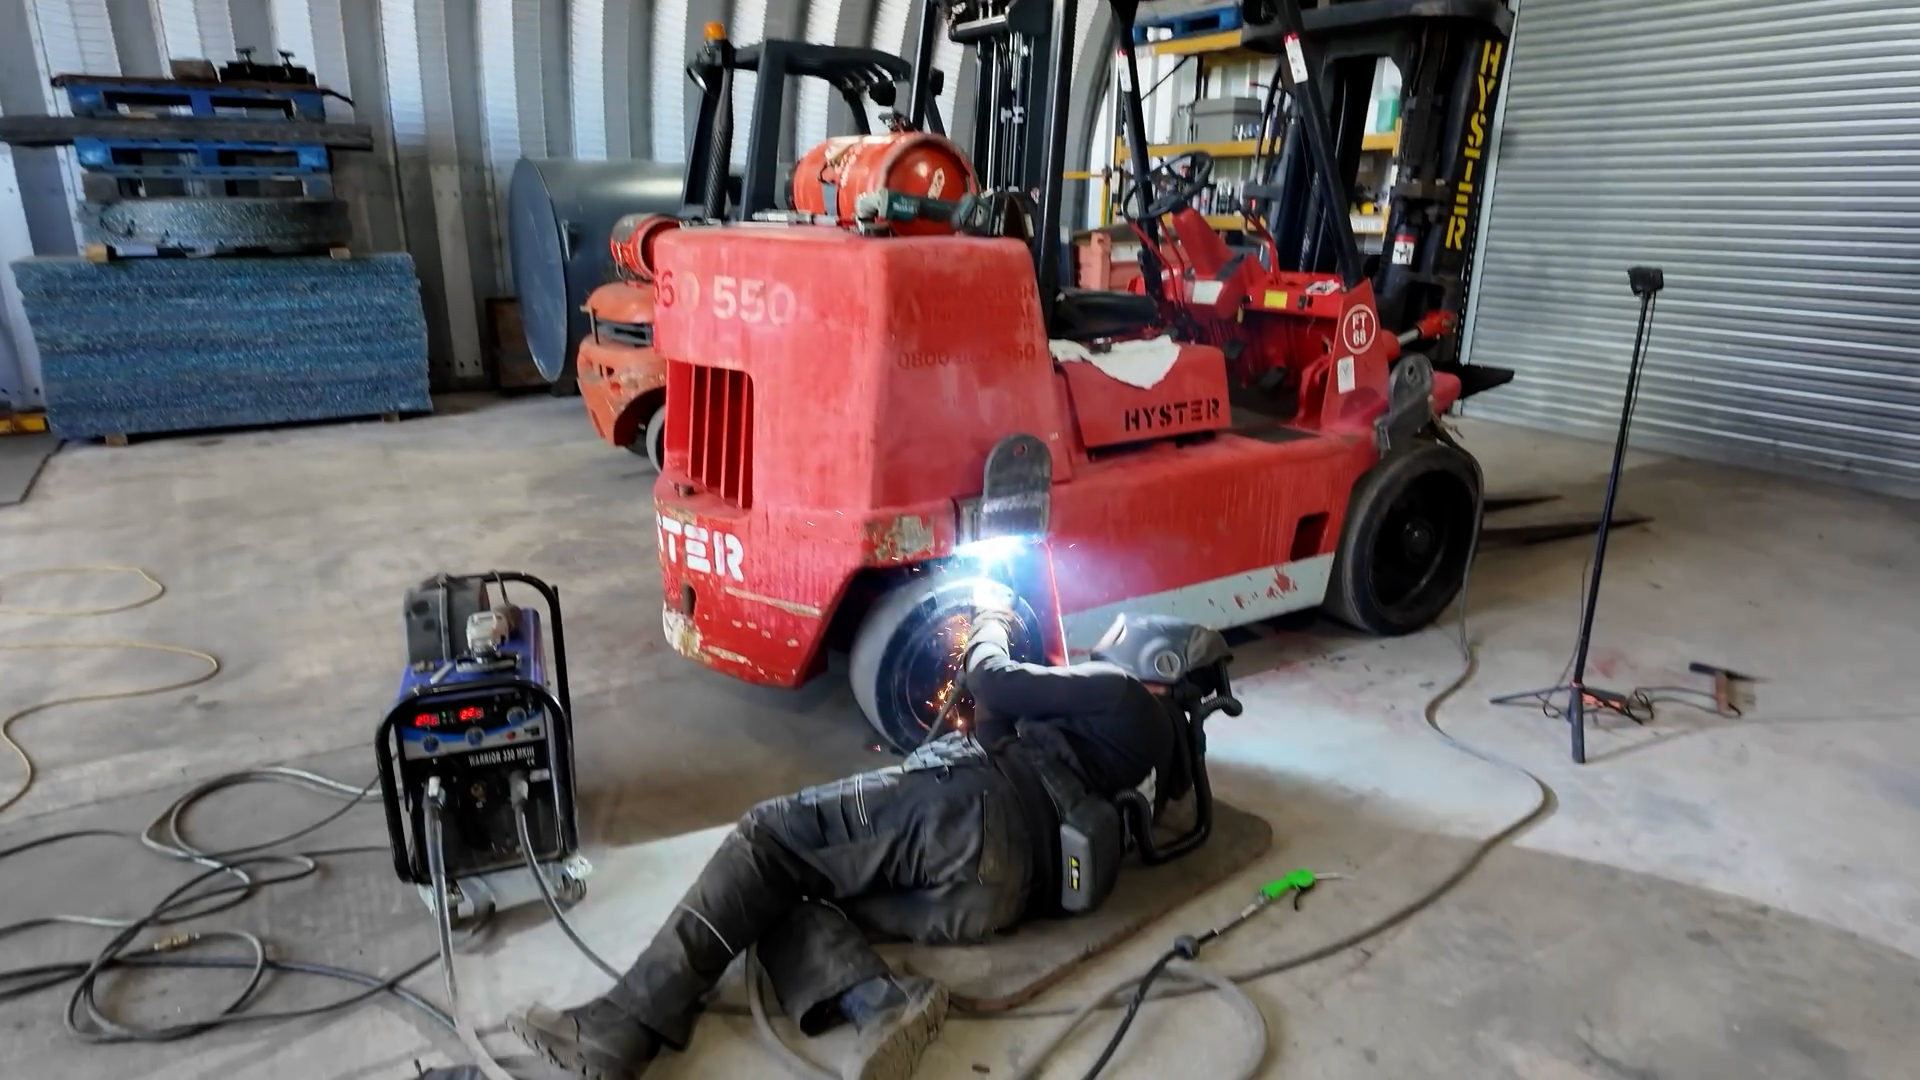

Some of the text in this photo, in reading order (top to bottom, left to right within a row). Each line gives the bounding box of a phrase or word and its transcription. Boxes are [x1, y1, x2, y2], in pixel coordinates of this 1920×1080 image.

[1445, 39, 1502, 250] HYSTER
[712, 274, 796, 327] 550
[1352, 312, 1367, 330] FT
[1124, 397, 1220, 432] HYSTER
[468, 750, 502, 768] WARRIOR
